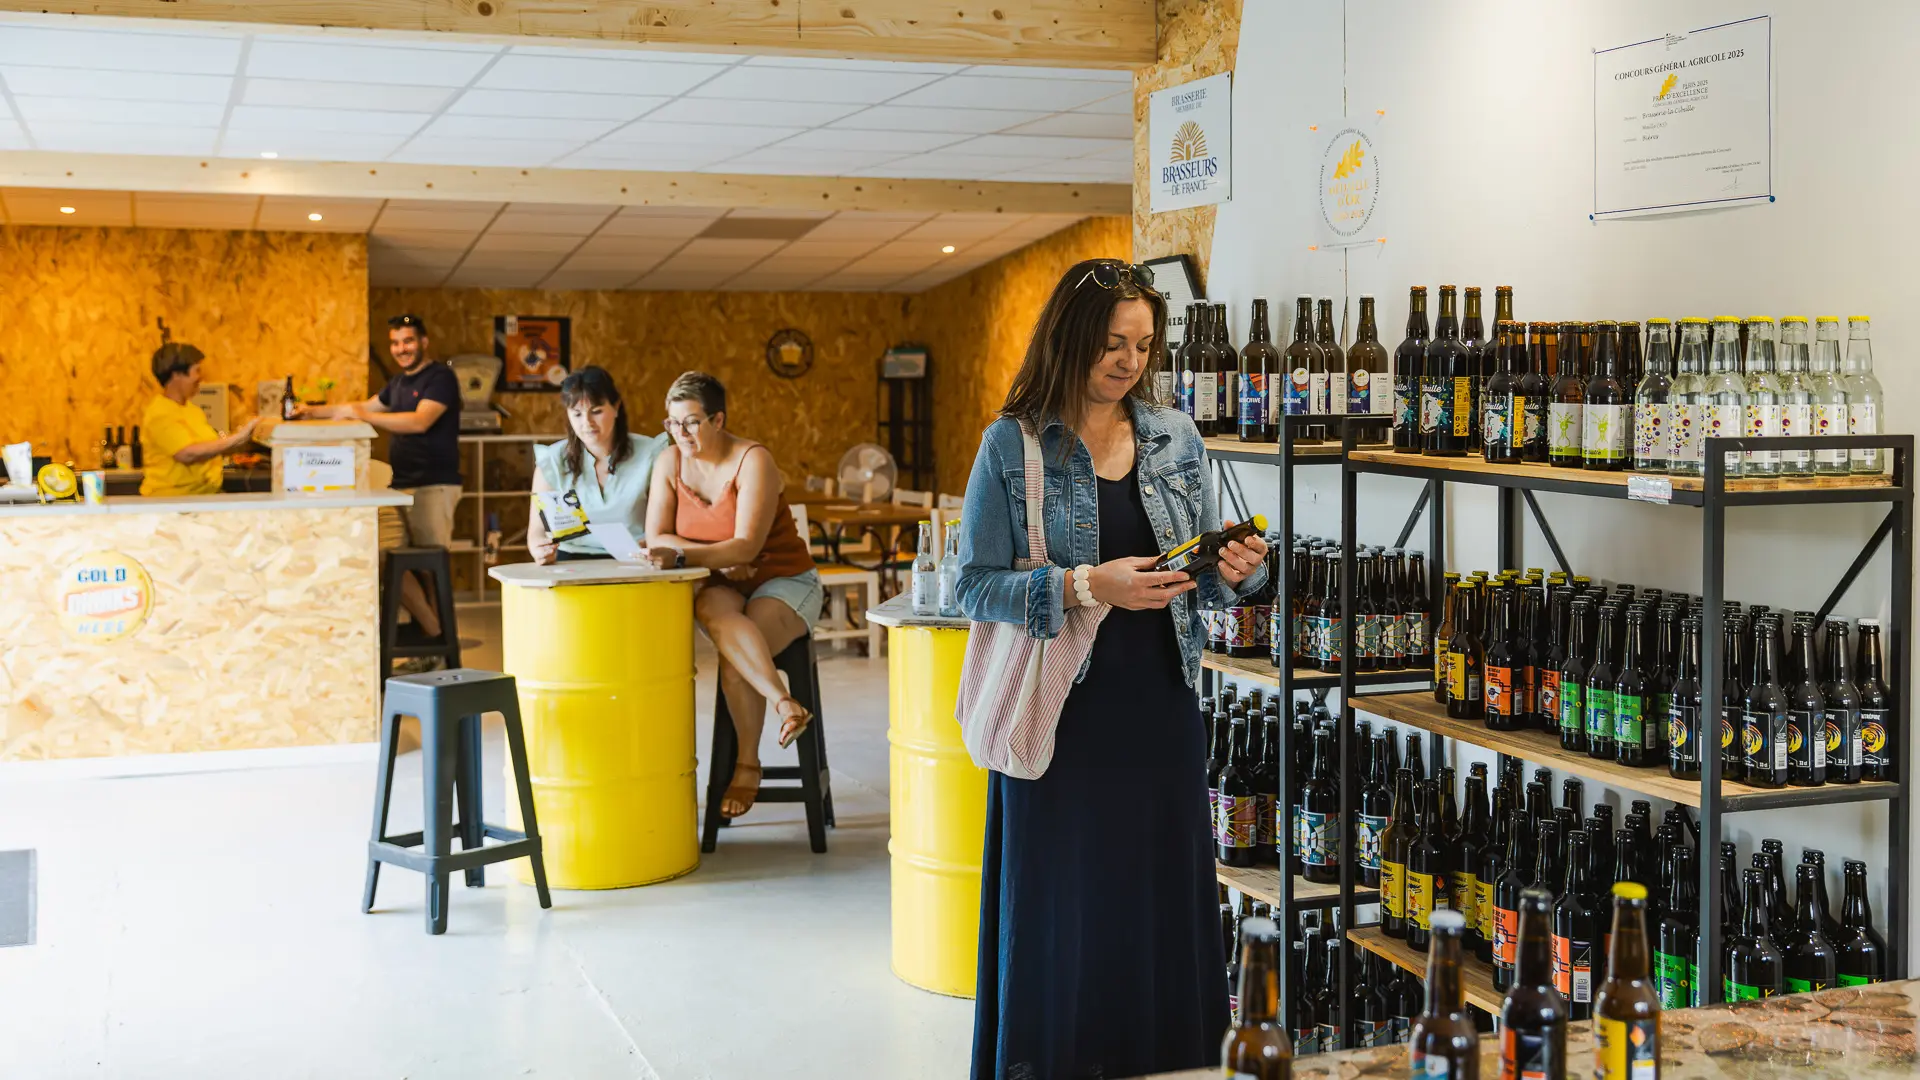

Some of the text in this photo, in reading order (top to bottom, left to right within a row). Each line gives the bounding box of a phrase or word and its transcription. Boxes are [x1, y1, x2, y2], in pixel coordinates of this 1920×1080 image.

[1614, 49, 1745, 81] CONCOURS GÉNÉRAL AGRICOLE 2025
[1171, 88, 1207, 107] BRASSERIE
[1666, 87, 1708, 100] D'EXCELLENCE
[1162, 156, 1218, 184] BRASSEURS
[1171, 179, 1208, 196] DE FRANCE
